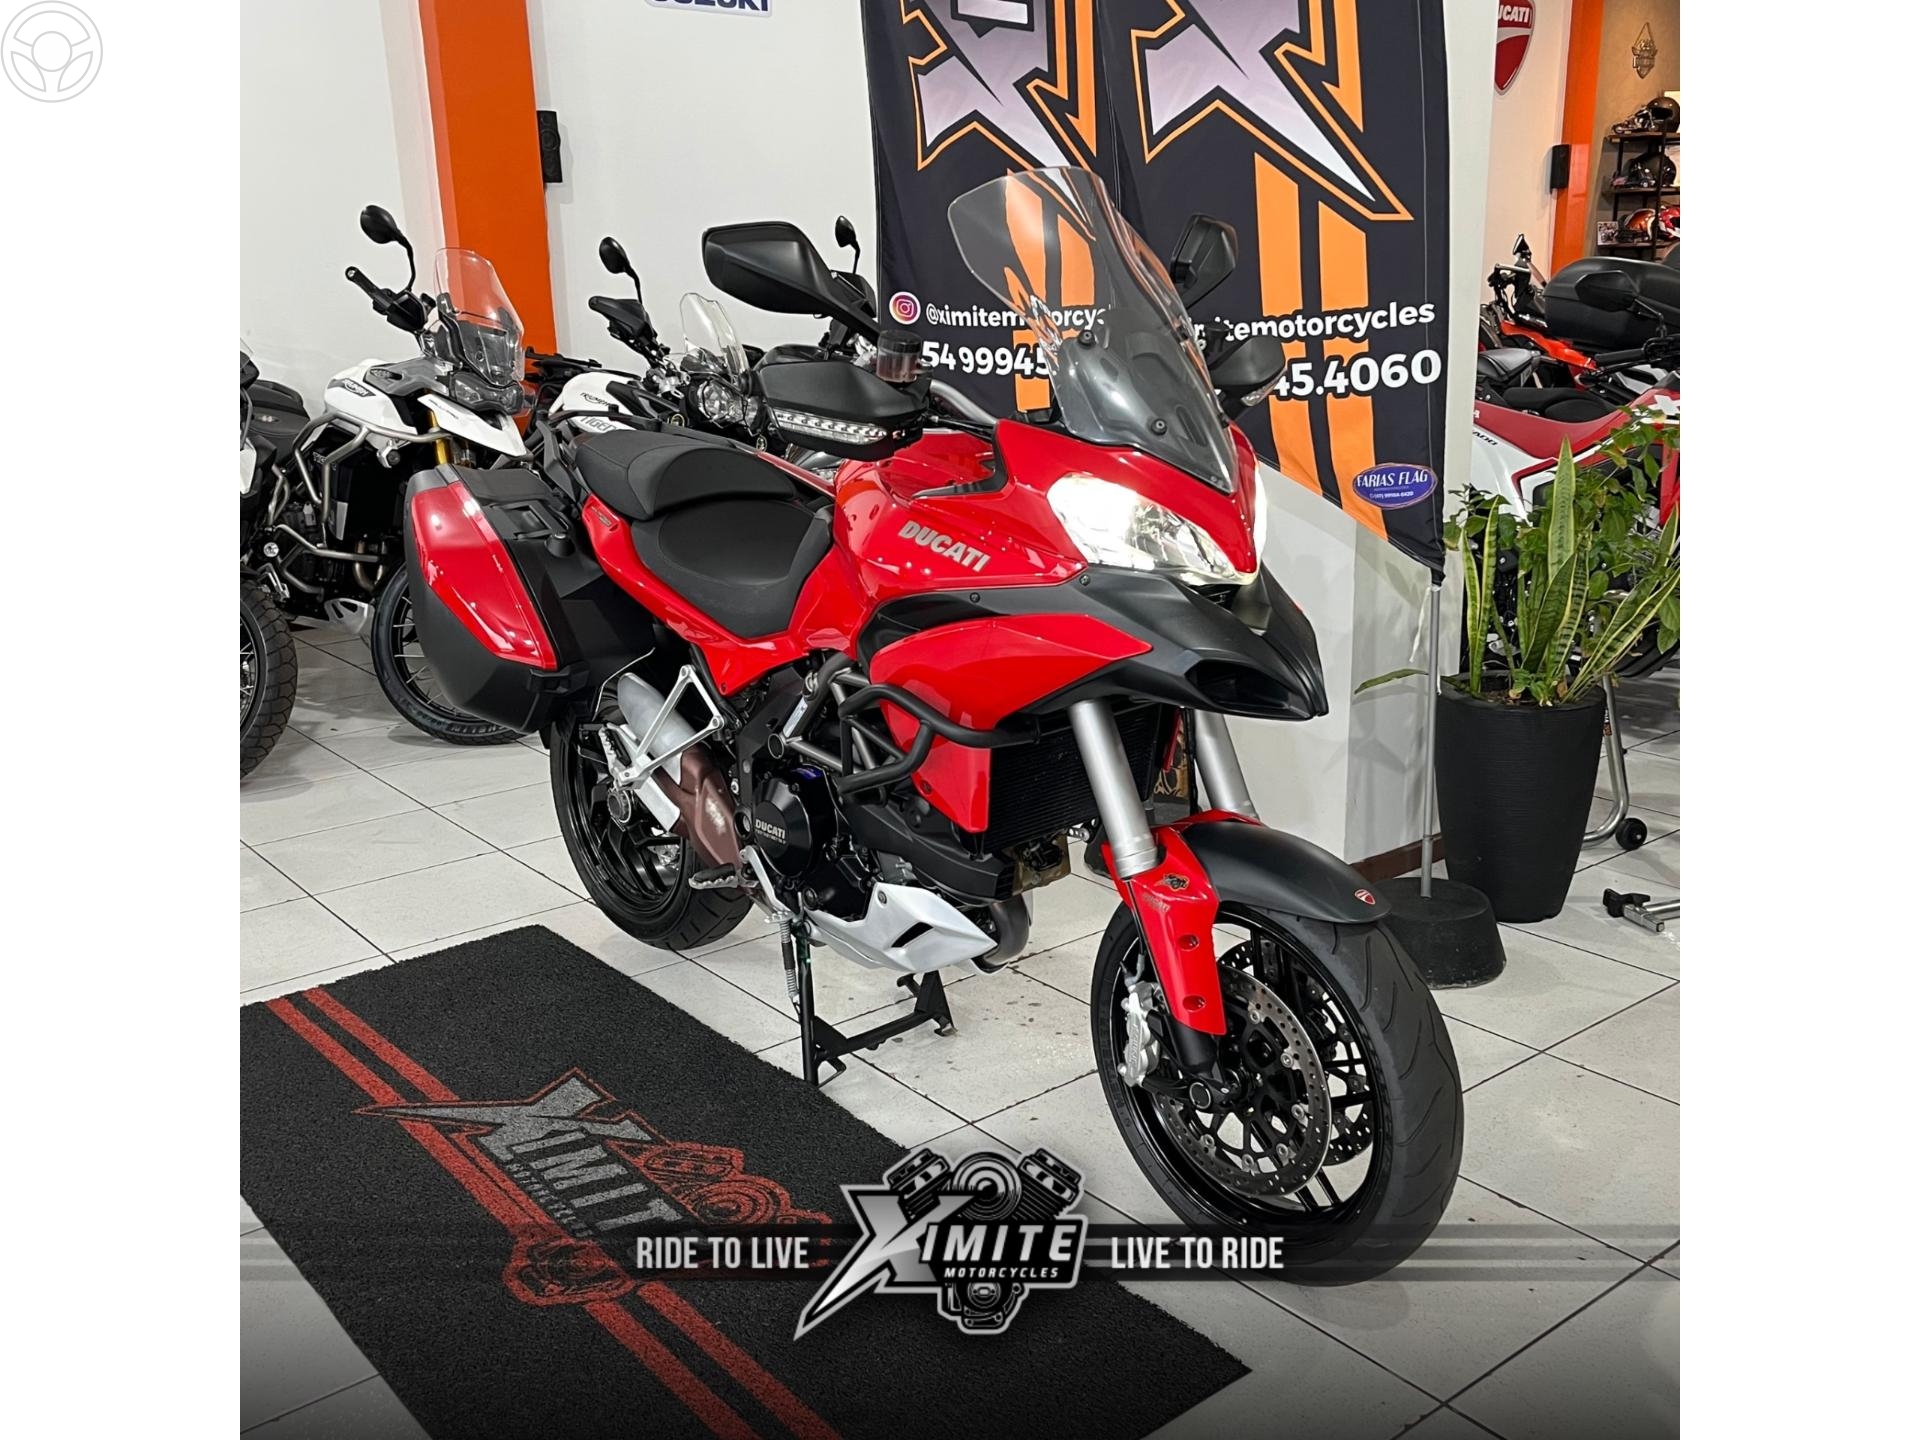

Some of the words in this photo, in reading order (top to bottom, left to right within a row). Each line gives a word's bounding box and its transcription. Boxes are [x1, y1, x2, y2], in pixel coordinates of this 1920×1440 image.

[654, 0, 769, 12] UKI
[1498, 5, 1531, 23] UCATI
[1356, 472, 1395, 488] FARIAS
[1398, 469, 1428, 486] FLAG
[898, 520, 991, 573] DUCATI
[755, 819, 785, 840] DUCATI
